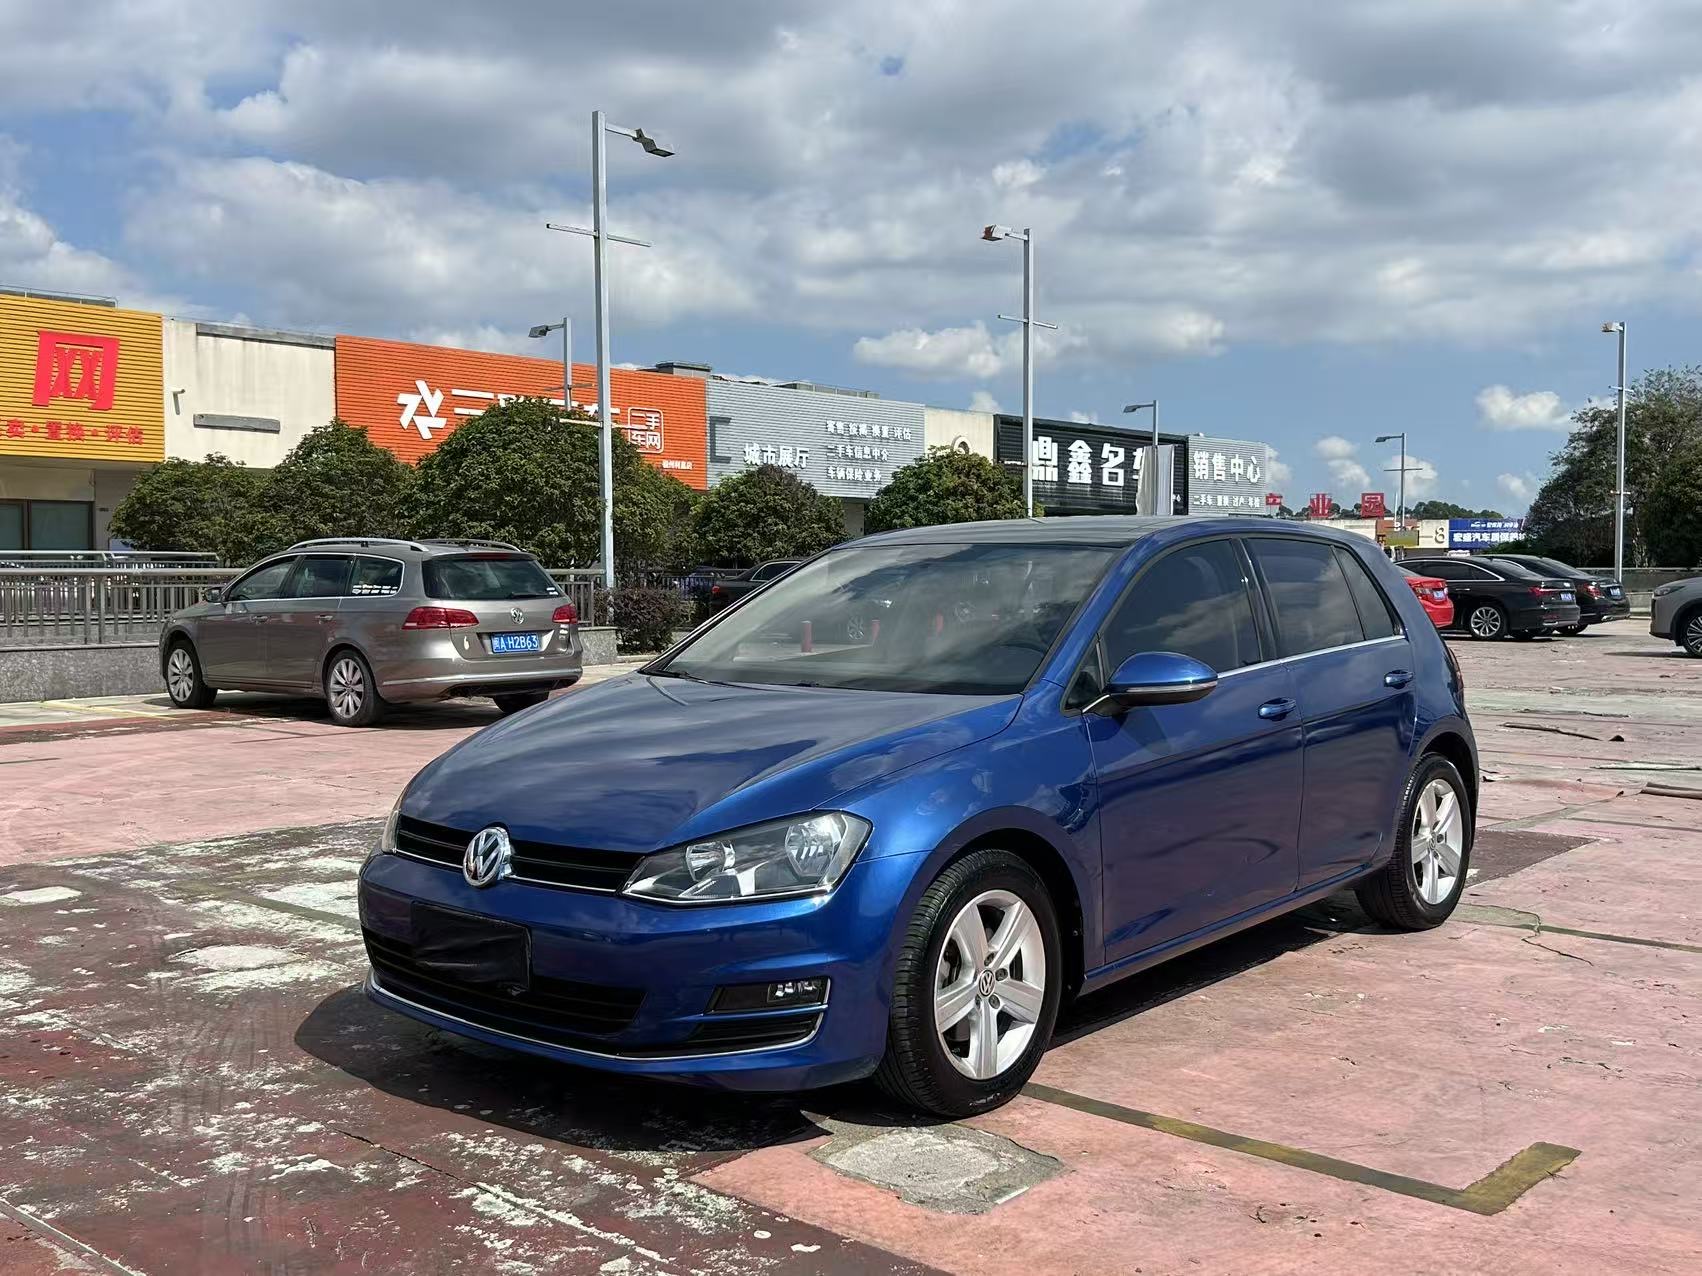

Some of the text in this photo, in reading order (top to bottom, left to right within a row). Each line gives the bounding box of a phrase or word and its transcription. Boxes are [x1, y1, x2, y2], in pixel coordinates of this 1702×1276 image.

[31, 328, 121, 411] 网
[743, 443, 810, 468] 城市展厅
[826, 444, 890, 461] 二手车信息中介
[827, 466, 882, 482] 车辆保险业务
[1193, 450, 1261, 483] 销售中心
[1193, 494, 1213, 506] 二手车
